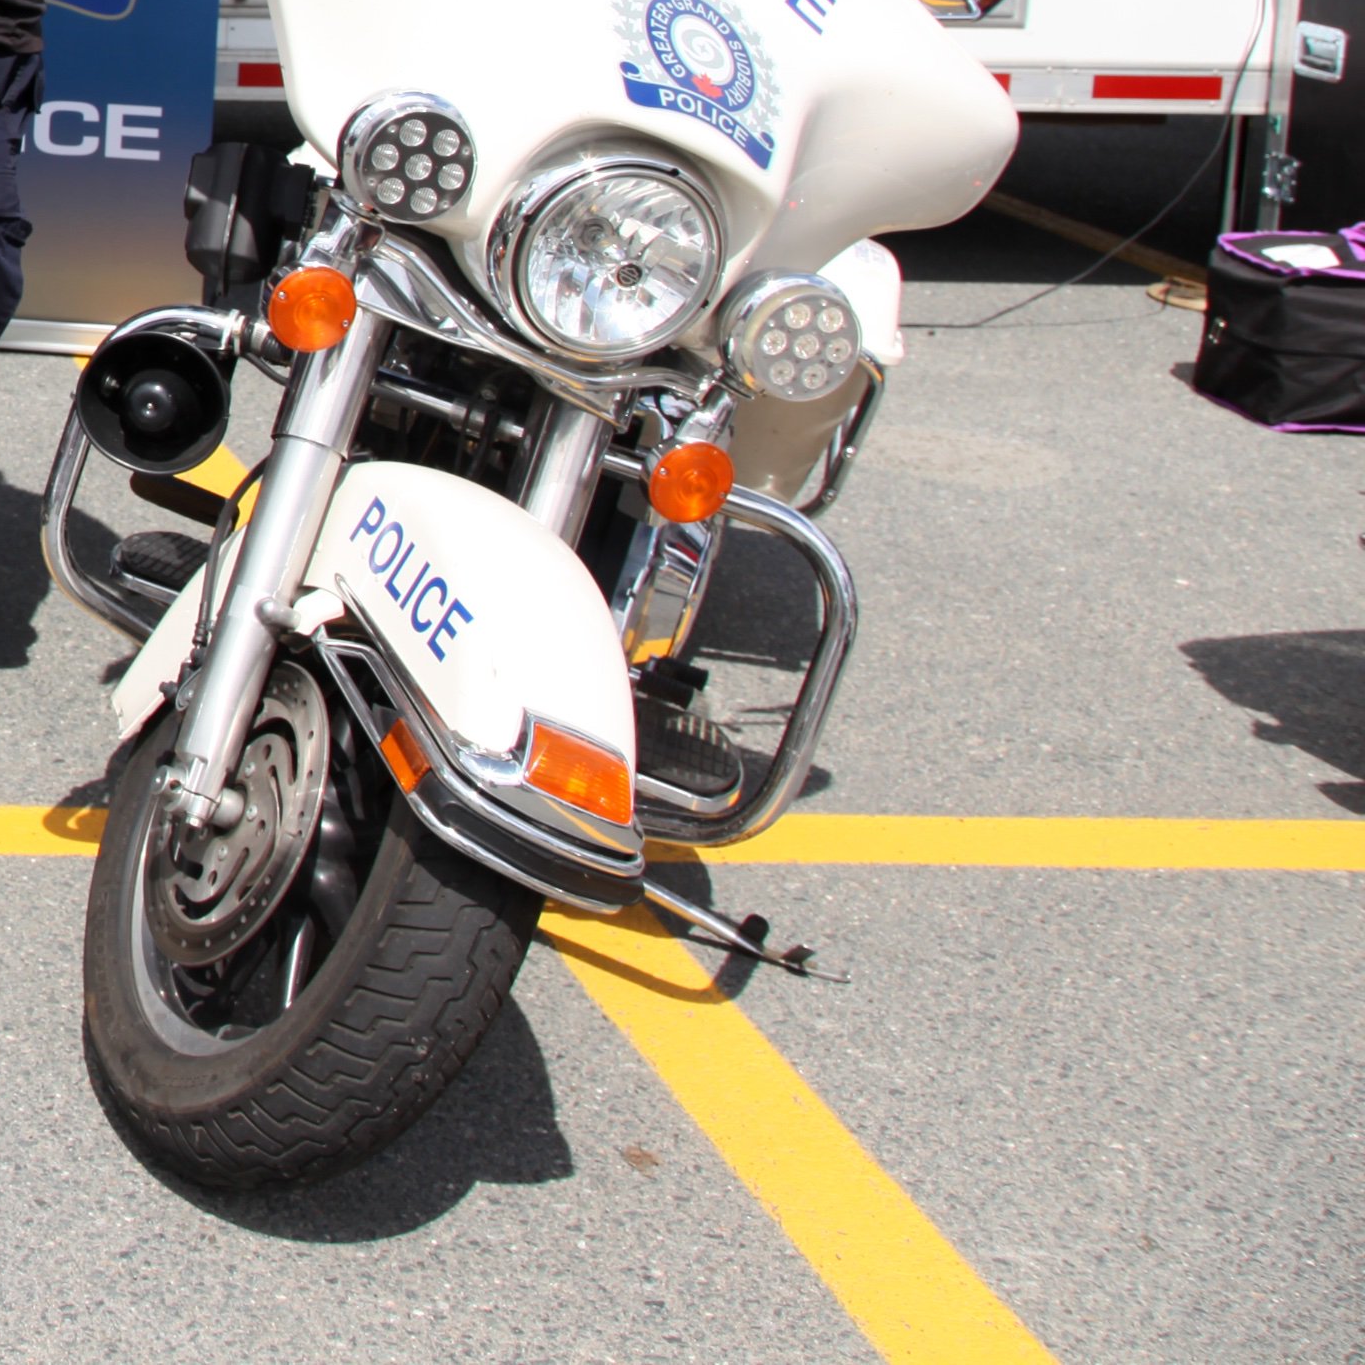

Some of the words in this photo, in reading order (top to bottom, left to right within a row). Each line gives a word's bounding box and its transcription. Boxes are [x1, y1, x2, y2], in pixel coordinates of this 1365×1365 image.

[650, 1, 686, 79] GREATER
[724, 39, 752, 107] SUDBURY
[658, 87, 750, 149] POLICE
[349, 495, 475, 664] POLICE
